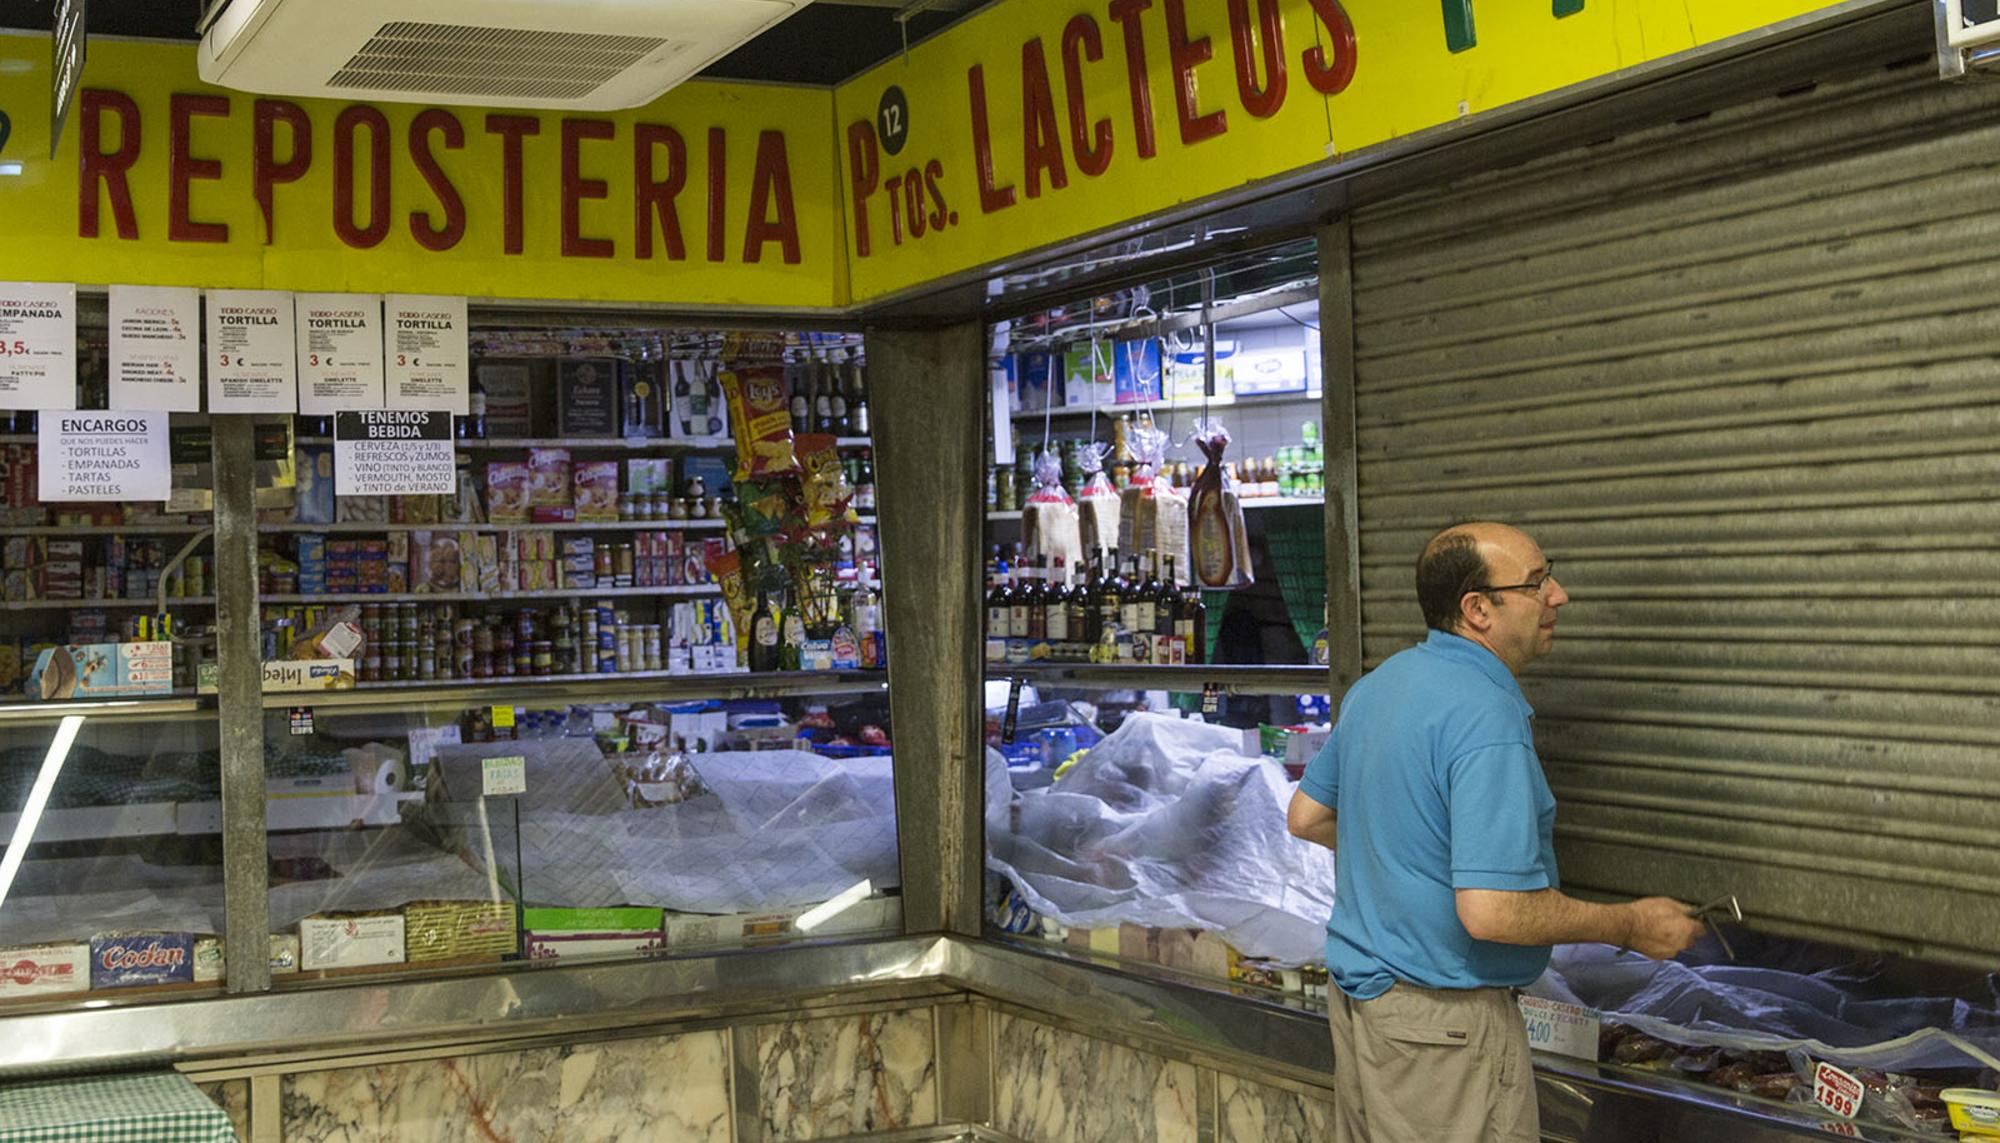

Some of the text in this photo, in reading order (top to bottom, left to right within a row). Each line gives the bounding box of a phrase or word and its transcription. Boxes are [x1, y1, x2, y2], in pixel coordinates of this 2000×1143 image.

[883, 104, 902, 137] 12
[78, 88, 803, 266] REPOSTERIA
[219, 316, 278, 325] TORTILLA
[308, 319, 366, 329] TORTILLA
[396, 319, 453, 330] TORTILLA
[220, 354, 230, 367] 3
[309, 354, 319, 367] 3
[397, 354, 406, 367] 3
[358, 411, 430, 424] TENEMOS
[61, 419, 148, 432] ENCARGOS
[368, 425, 422, 438] BEBIDA
[95, 437, 124, 445] PUEDES
[125, 437, 149, 445] HACER
[354, 442, 400, 451] CERVEZA
[68, 447, 127, 457] TORTILLAS
[354, 452, 409, 461] REFRESCOS
[415, 452, 451, 461] ZUMOS
[68, 459, 140, 470] EMPANADAS
[354, 463, 382, 472] VINO
[68, 472, 111, 482] TARTAS
[416, 473, 451, 482] MOSTO
[68, 485, 121, 495] PASTELES
[362, 483, 392, 492] TINTO
[408, 482, 448, 491] VERANO
[102, 943, 185, 970] Codan
[1816, 1085, 1853, 1116] 1599
